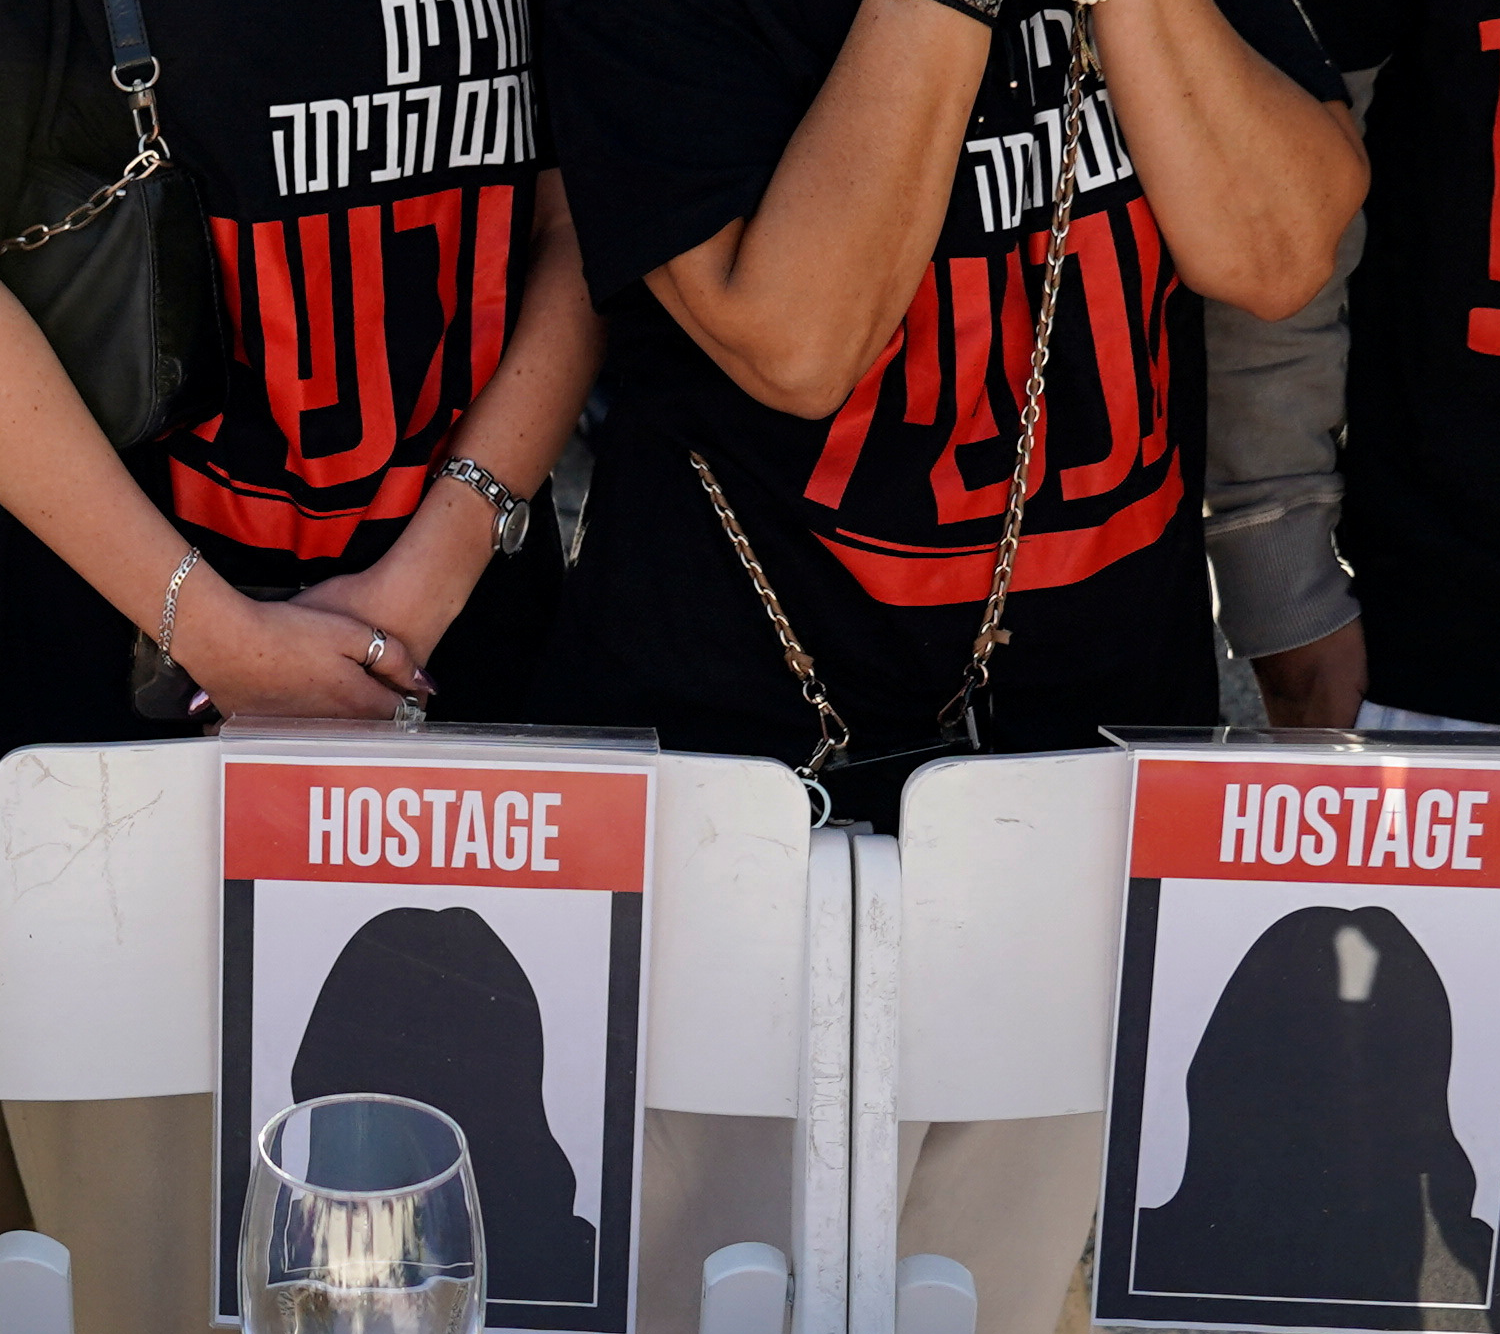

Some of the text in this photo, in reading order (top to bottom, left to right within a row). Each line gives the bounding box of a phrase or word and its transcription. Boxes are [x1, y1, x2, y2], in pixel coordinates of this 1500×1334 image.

[269, 70, 538, 197] ותם הביתה
[307, 784, 562, 873] HOSTAGE
[1218, 782, 1490, 872] HOSTAGE
